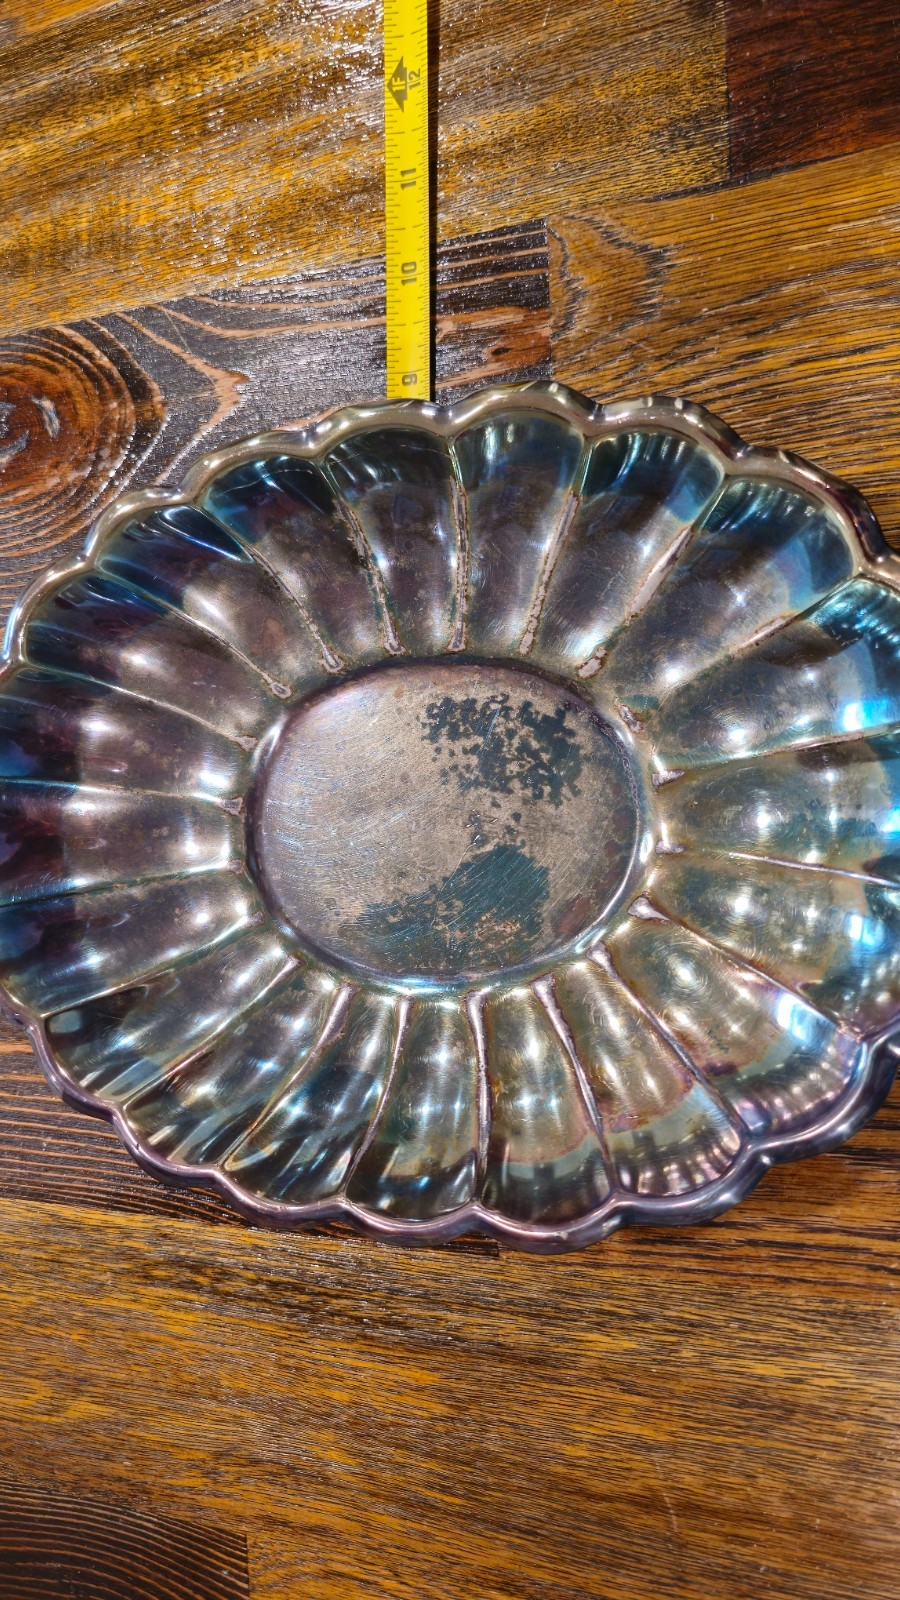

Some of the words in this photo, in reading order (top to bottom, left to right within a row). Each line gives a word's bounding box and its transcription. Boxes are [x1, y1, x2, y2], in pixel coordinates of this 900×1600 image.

[392, 77, 406, 92] 1F
[408, 68, 421, 90] 12
[401, 168, 416, 190] 11
[401, 261, 417, 286] 10
[402, 373, 417, 386] 9
